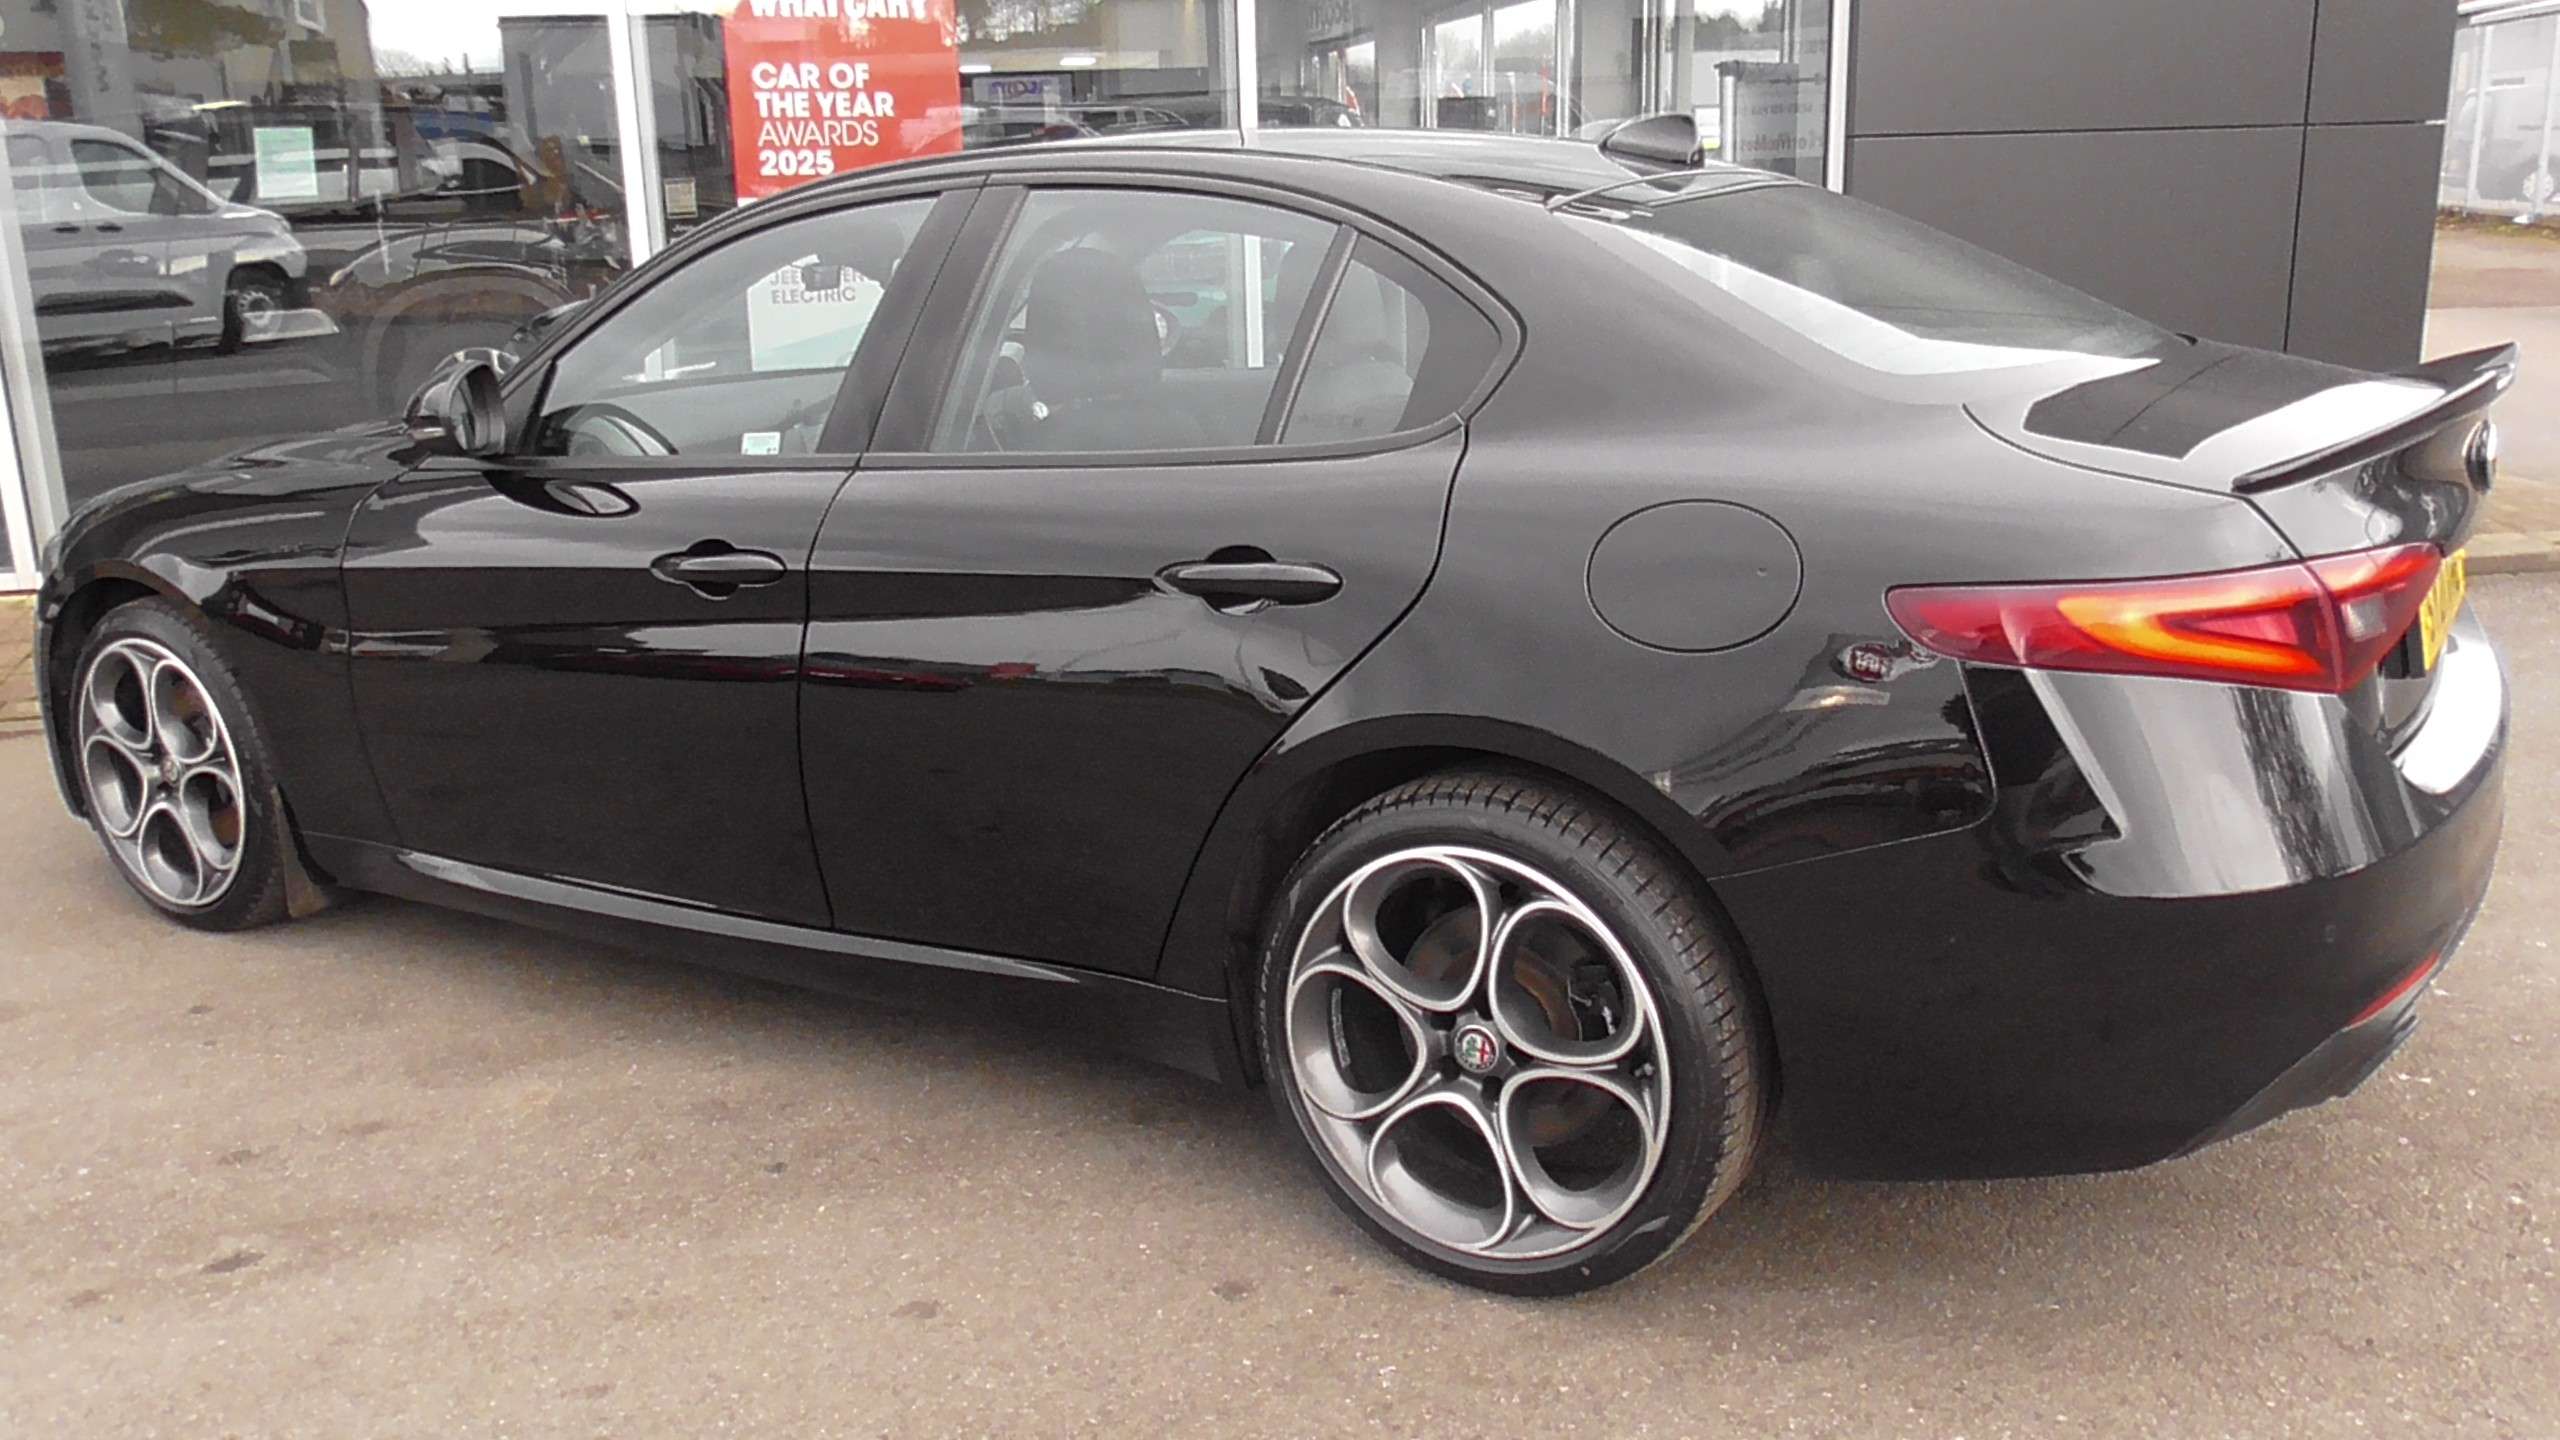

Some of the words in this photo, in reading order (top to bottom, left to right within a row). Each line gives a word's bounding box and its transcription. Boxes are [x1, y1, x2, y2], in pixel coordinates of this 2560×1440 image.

[751, 0, 838, 17] WHAT
[752, 62, 820, 89] CAR
[829, 62, 869, 89] OF
[754, 91, 809, 118] THE
[815, 91, 894, 117] YEAR
[757, 120, 879, 147] AWARDS
[759, 150, 834, 176] 2025
[772, 287, 856, 304] ELECTRIC
